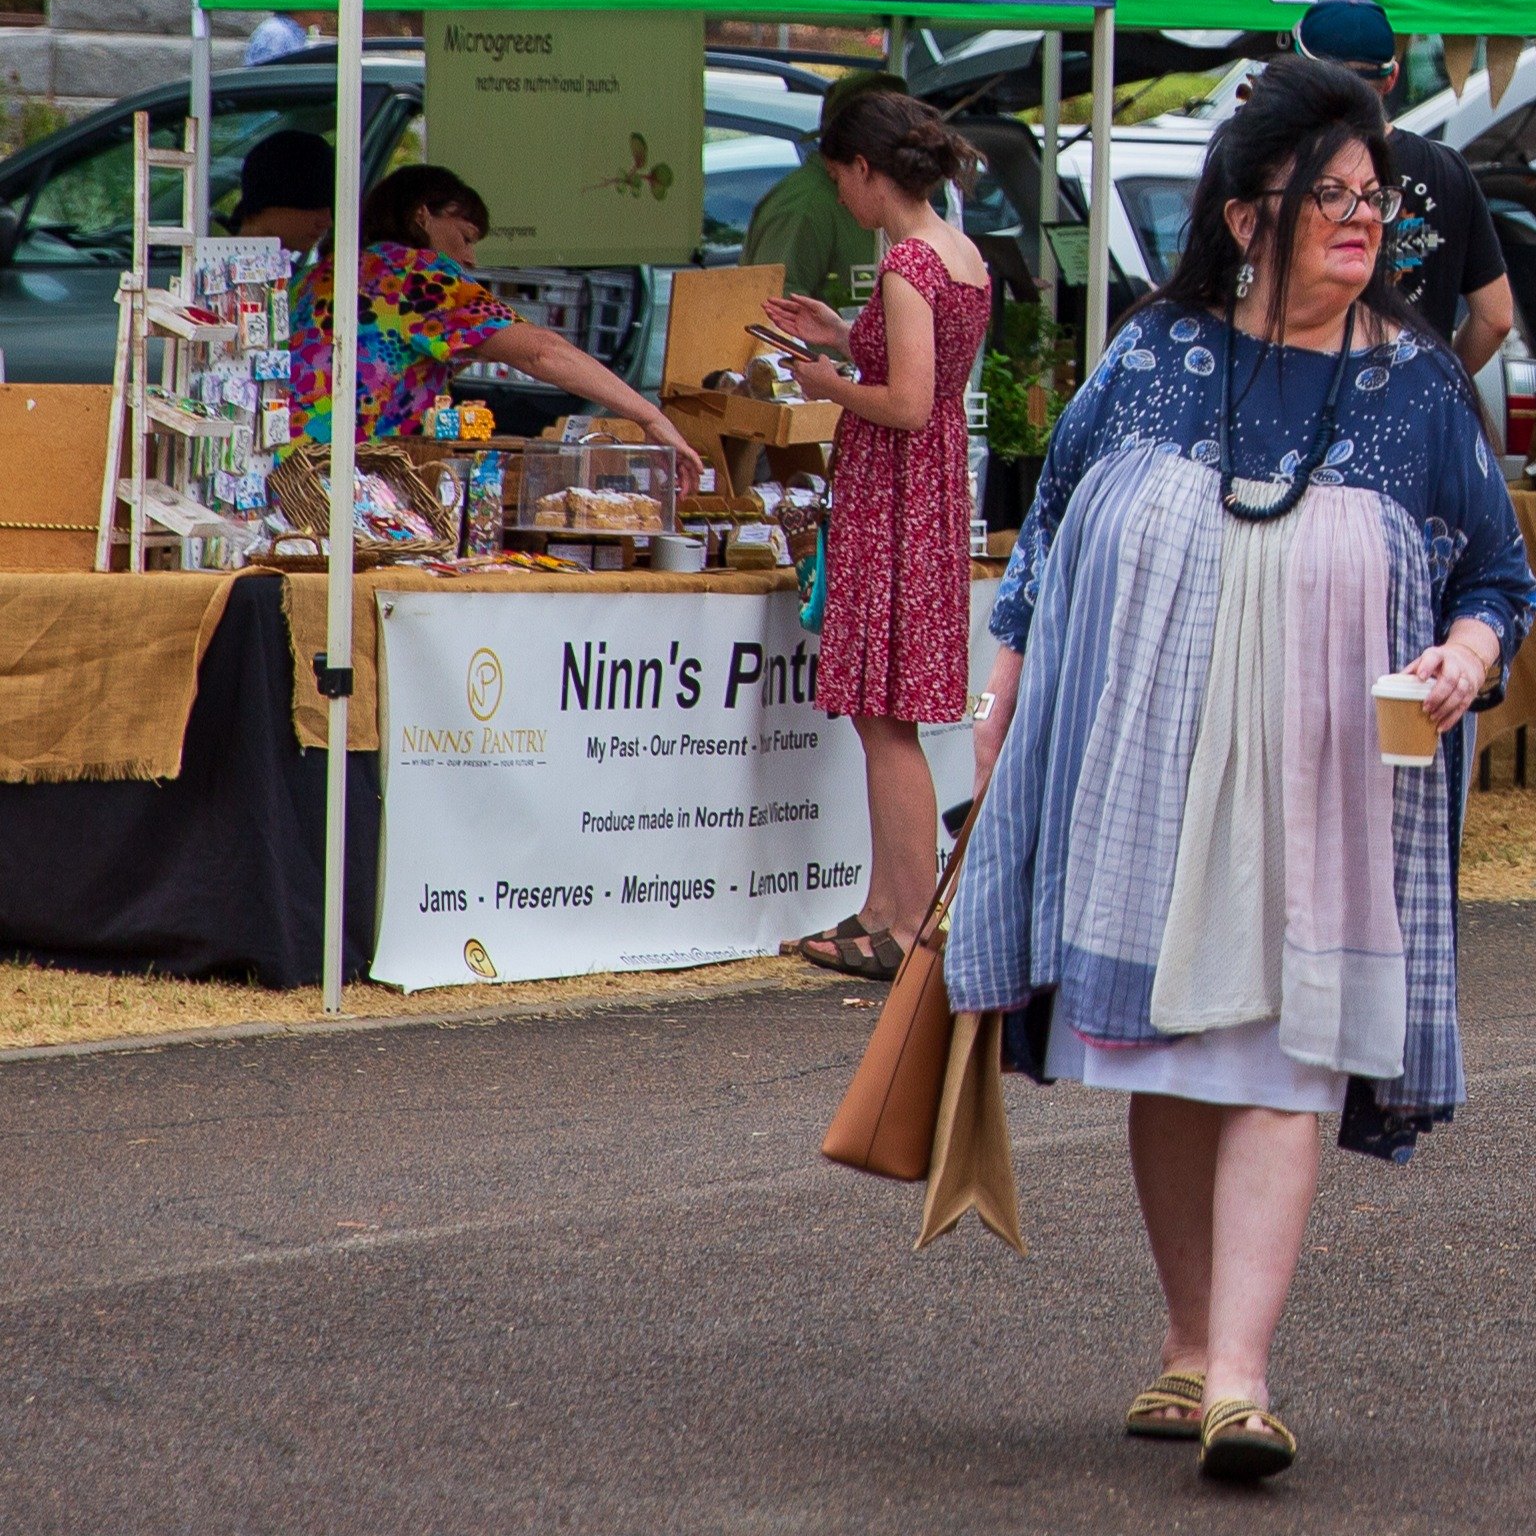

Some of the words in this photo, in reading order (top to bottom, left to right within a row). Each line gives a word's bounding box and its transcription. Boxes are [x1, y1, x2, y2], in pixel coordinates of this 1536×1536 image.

[443, 25, 553, 62] Microgreens
[586, 74, 621, 96] punch
[1400, 174, 1437, 212] TON
[560, 640, 703, 711] Ninn's
[402, 725, 475, 754] NINNS
[481, 726, 548, 754] PANTRY
[587, 736, 606, 763] My
[610, 736, 640, 758] Past
[650, 734, 677, 756] Our
[680, 733, 748, 756] Present
[773, 728, 819, 752] Future
[582, 810, 635, 833] Produce
[638, 809, 674, 830] made
[678, 807, 690, 828] in
[695, 806, 744, 829] North
[419, 883, 467, 913] Jams
[495, 880, 594, 910] Preserves
[621, 874, 716, 908] Meringues
[806, 861, 862, 890] Butter
